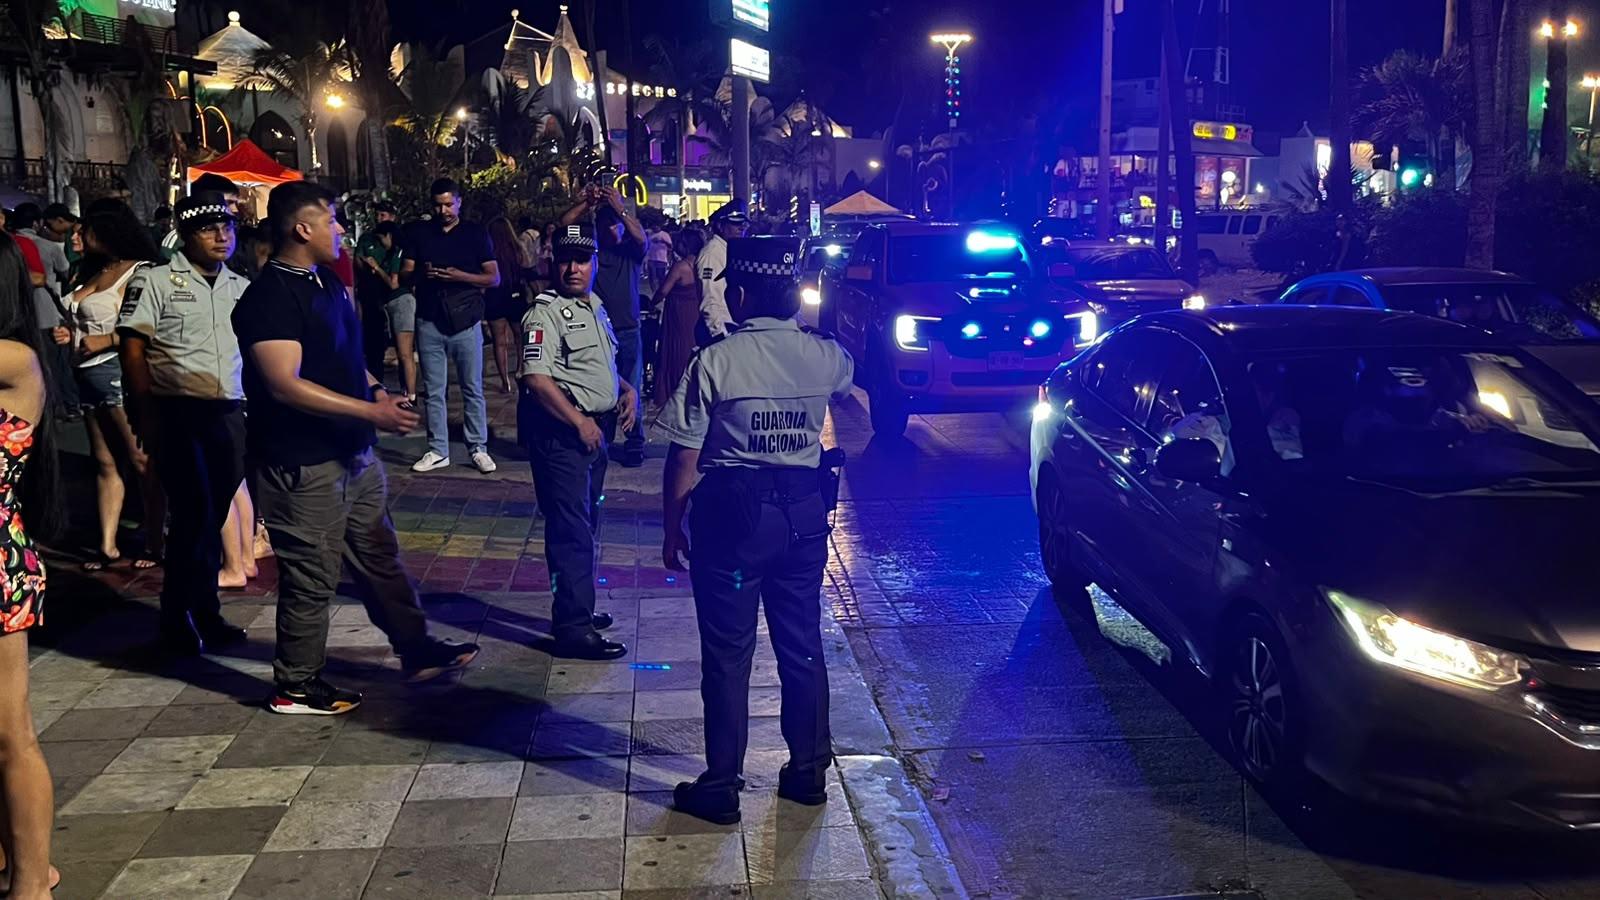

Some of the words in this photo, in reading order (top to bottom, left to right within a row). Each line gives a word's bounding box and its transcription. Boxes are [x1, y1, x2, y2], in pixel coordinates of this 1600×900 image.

[783, 252, 794, 264] GN
[751, 411, 807, 431] GUARDIA
[747, 433, 808, 454] NACIONAL
